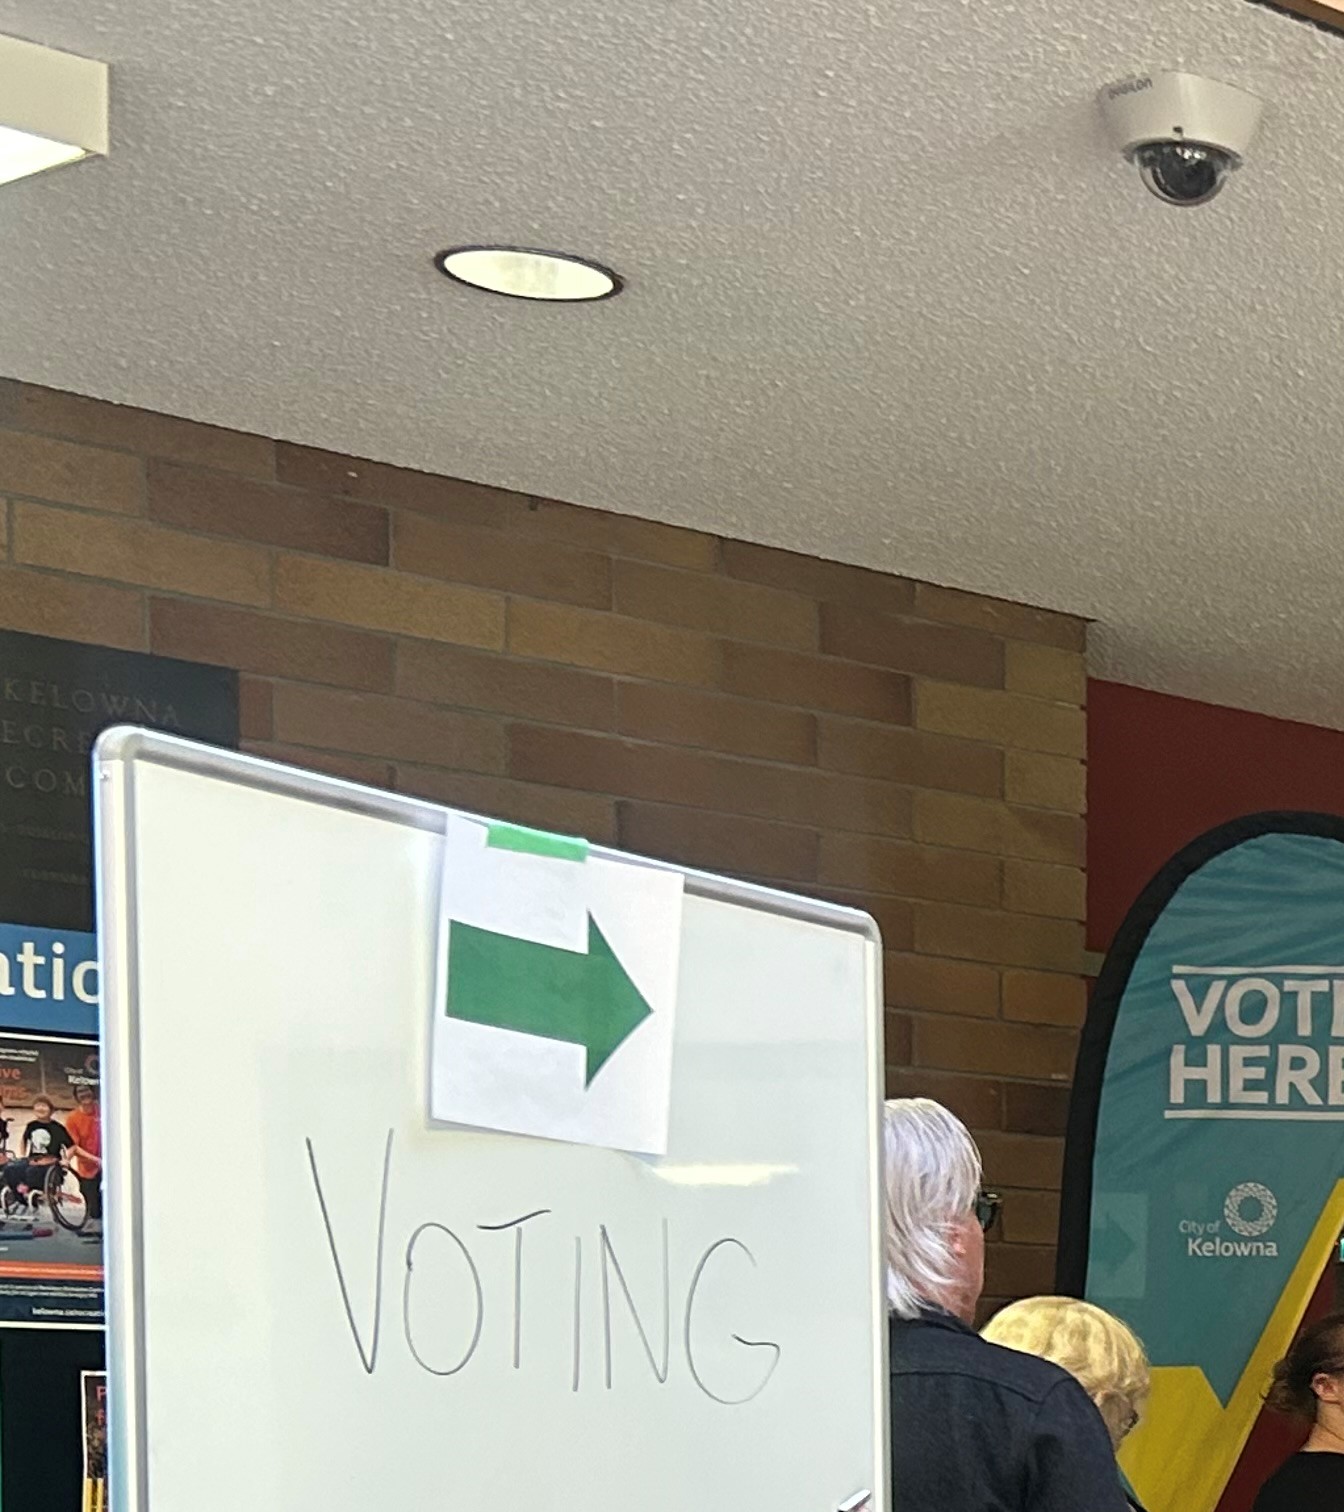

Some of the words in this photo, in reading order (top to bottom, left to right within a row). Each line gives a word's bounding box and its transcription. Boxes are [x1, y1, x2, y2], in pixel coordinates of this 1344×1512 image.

[5, 679, 179, 726] KELOWNA
[1179, 1219, 1205, 1236] City
[1206, 1219, 1221, 1233] of
[1187, 1237, 1279, 1257] Kelowna
[305, 1127, 781, 1405] VOTING
